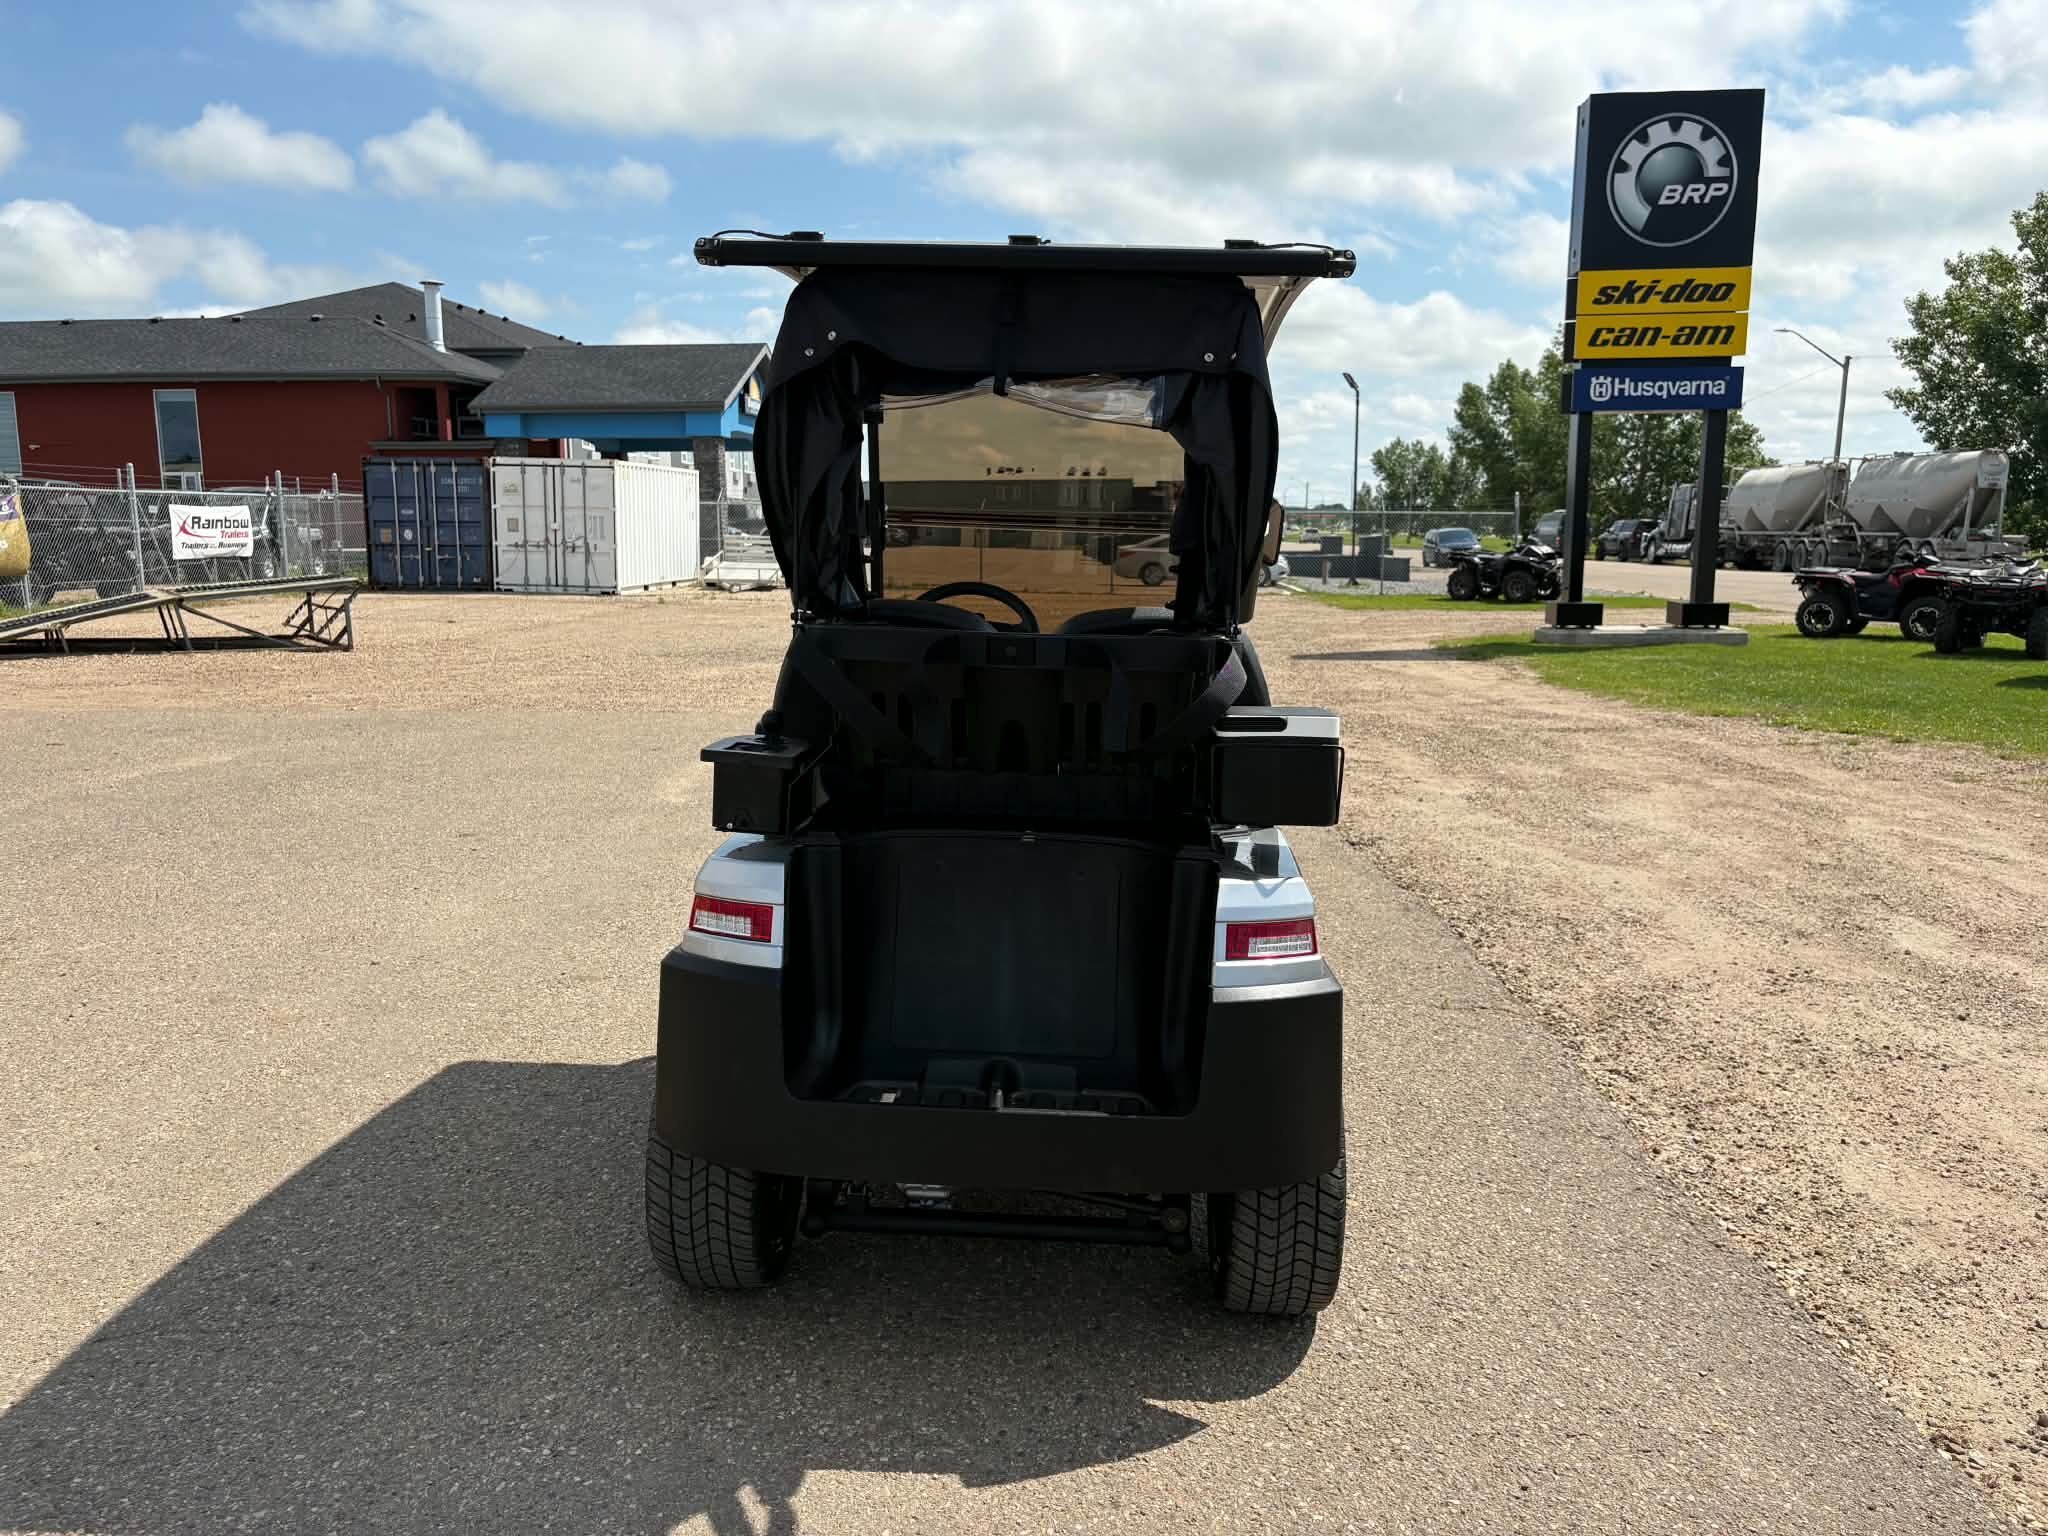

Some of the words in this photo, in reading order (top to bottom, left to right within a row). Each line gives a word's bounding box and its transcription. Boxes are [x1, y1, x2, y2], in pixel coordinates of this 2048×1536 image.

[1658, 183, 1729, 205] BRP
[1592, 278, 1736, 305] ski-doo
[1588, 325, 1735, 347] can-am
[1613, 377, 1726, 399] Husqvarna
[191, 515, 249, 529] Rainbow
